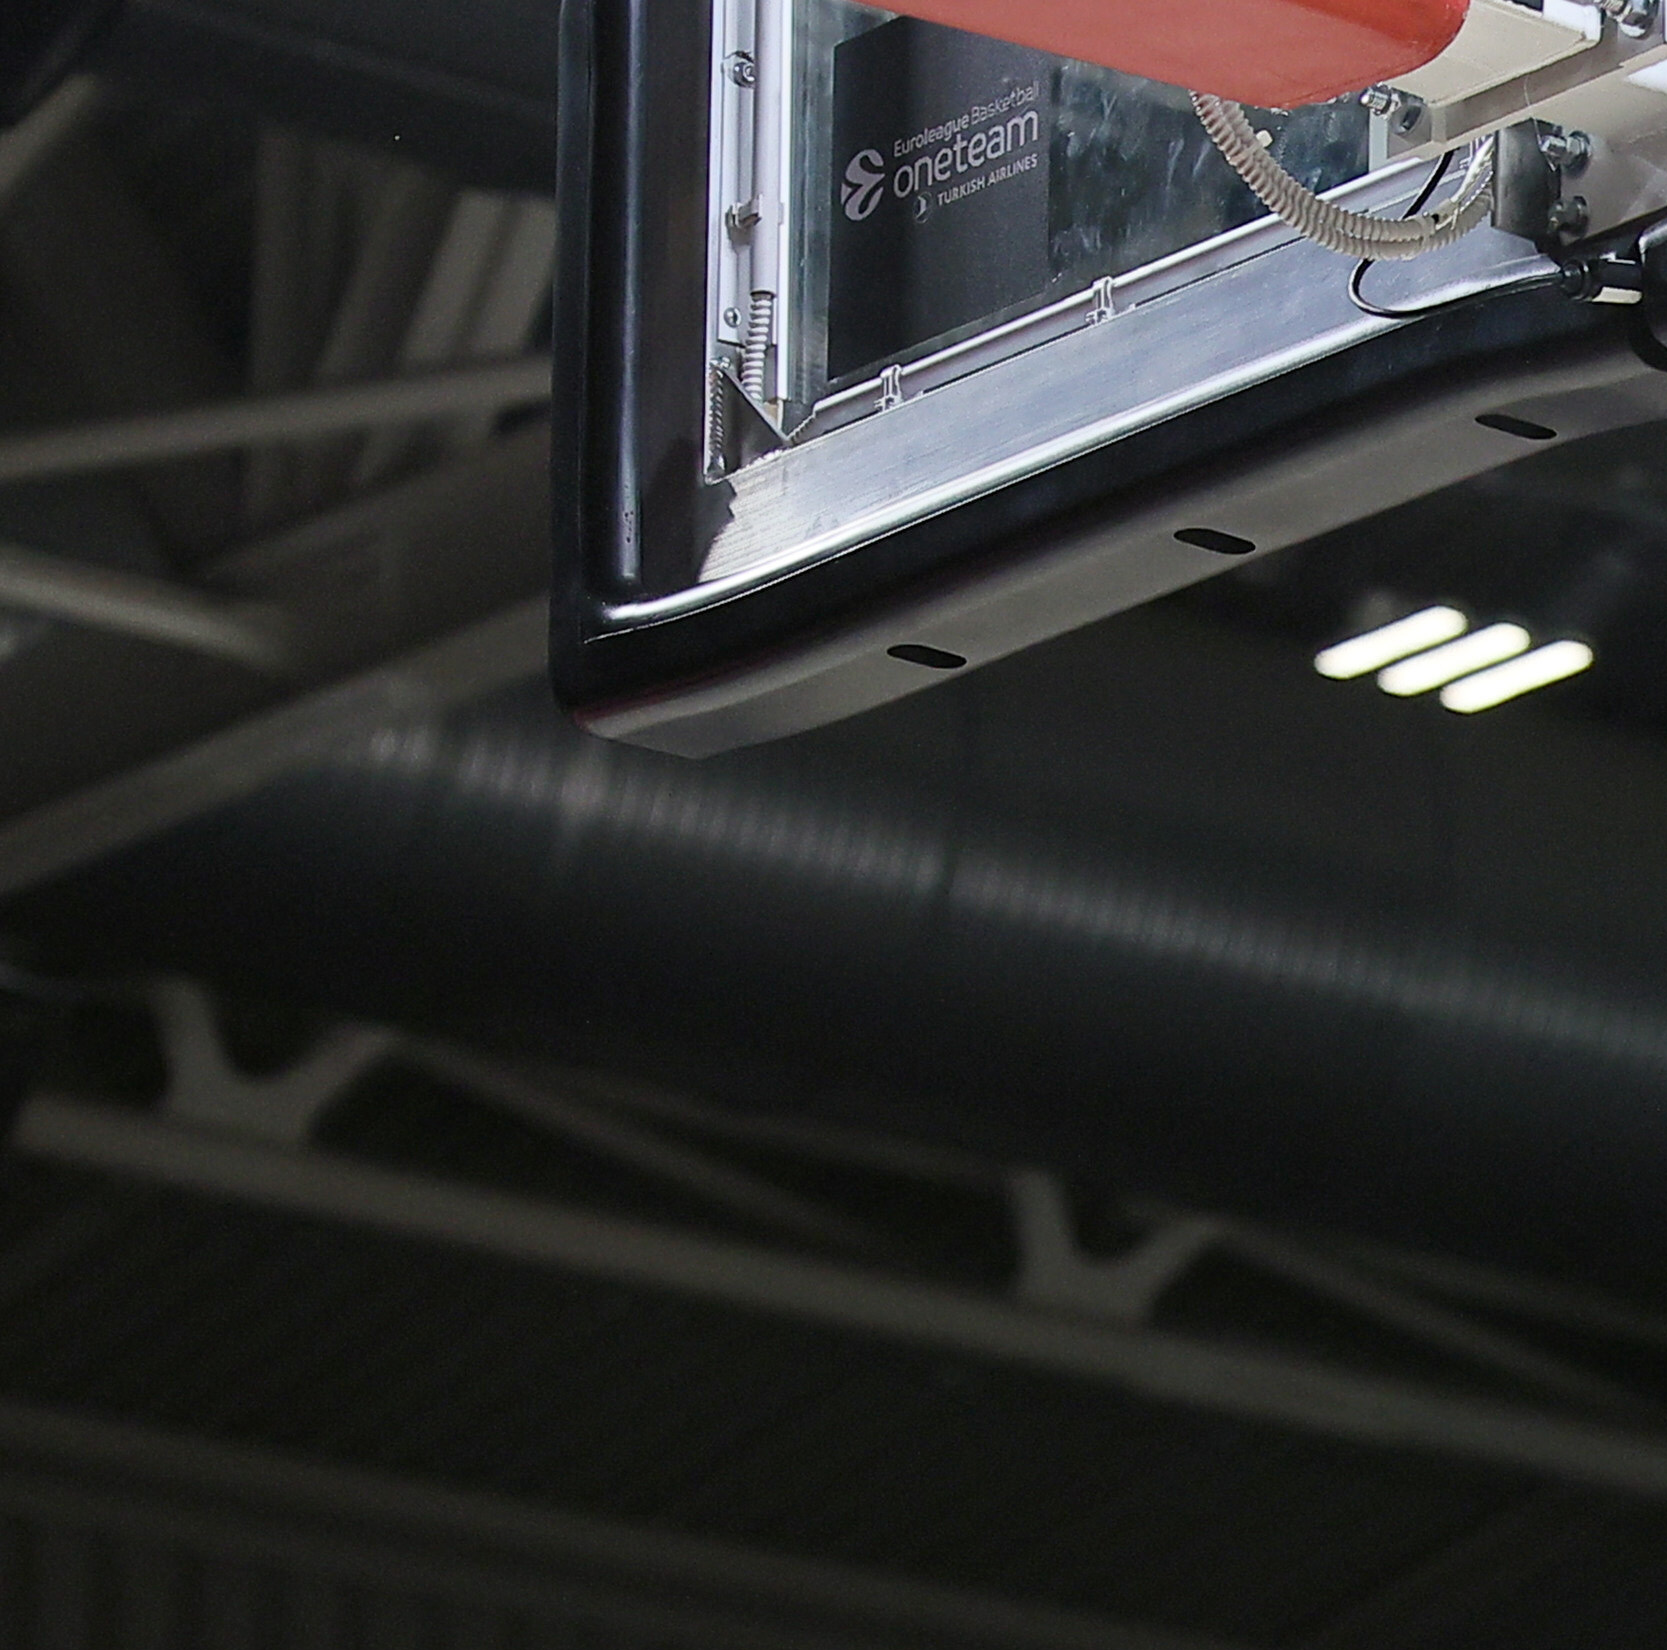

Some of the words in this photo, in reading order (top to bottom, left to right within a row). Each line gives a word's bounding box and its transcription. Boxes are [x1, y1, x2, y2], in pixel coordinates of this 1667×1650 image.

[893, 109, 1040, 198] oneteam
[894, 114, 969, 158] Euroleague
[970, 80, 1040, 125] Basketball
[936, 176, 986, 207] TURKISH
[986, 153, 1039, 187] AIRLINES
